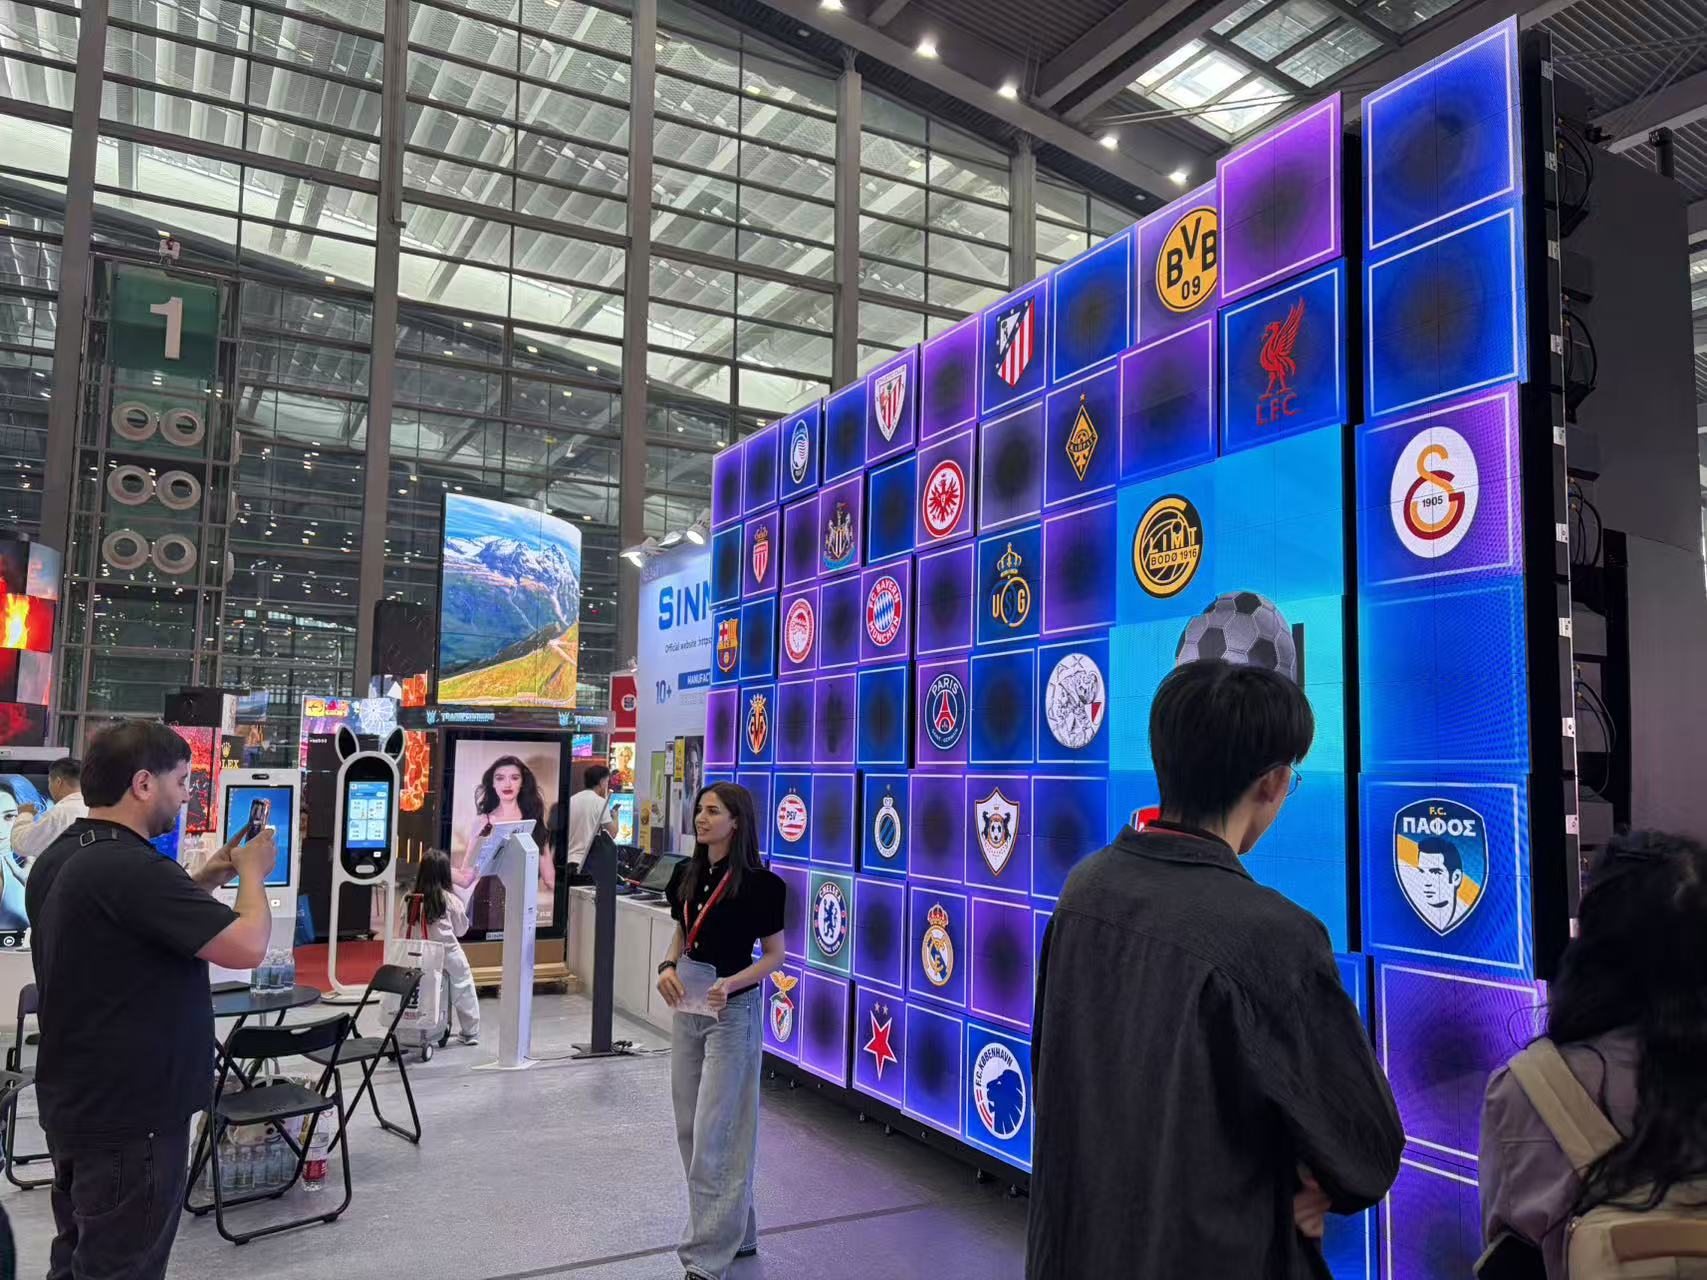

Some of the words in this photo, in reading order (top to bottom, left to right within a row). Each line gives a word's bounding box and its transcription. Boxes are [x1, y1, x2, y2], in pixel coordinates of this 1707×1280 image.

[1166, 216, 1218, 289] BVB
[1181, 275, 1202, 300] 09
[149, 295, 184, 361] 1
[1256, 393, 1299, 426] LFC
[1422, 495, 1444, 508] 1905
[1151, 552, 1178, 566] BODØ
[1180, 547, 1197, 561] 1916
[876, 579, 900, 603] BAYERN
[655, 679, 672, 705] 10+
[931, 677, 959, 697] PARIS
[1429, 806, 1447, 816] F.C.
[1402, 816, 1477, 838] ΠΑΦΟΣ
